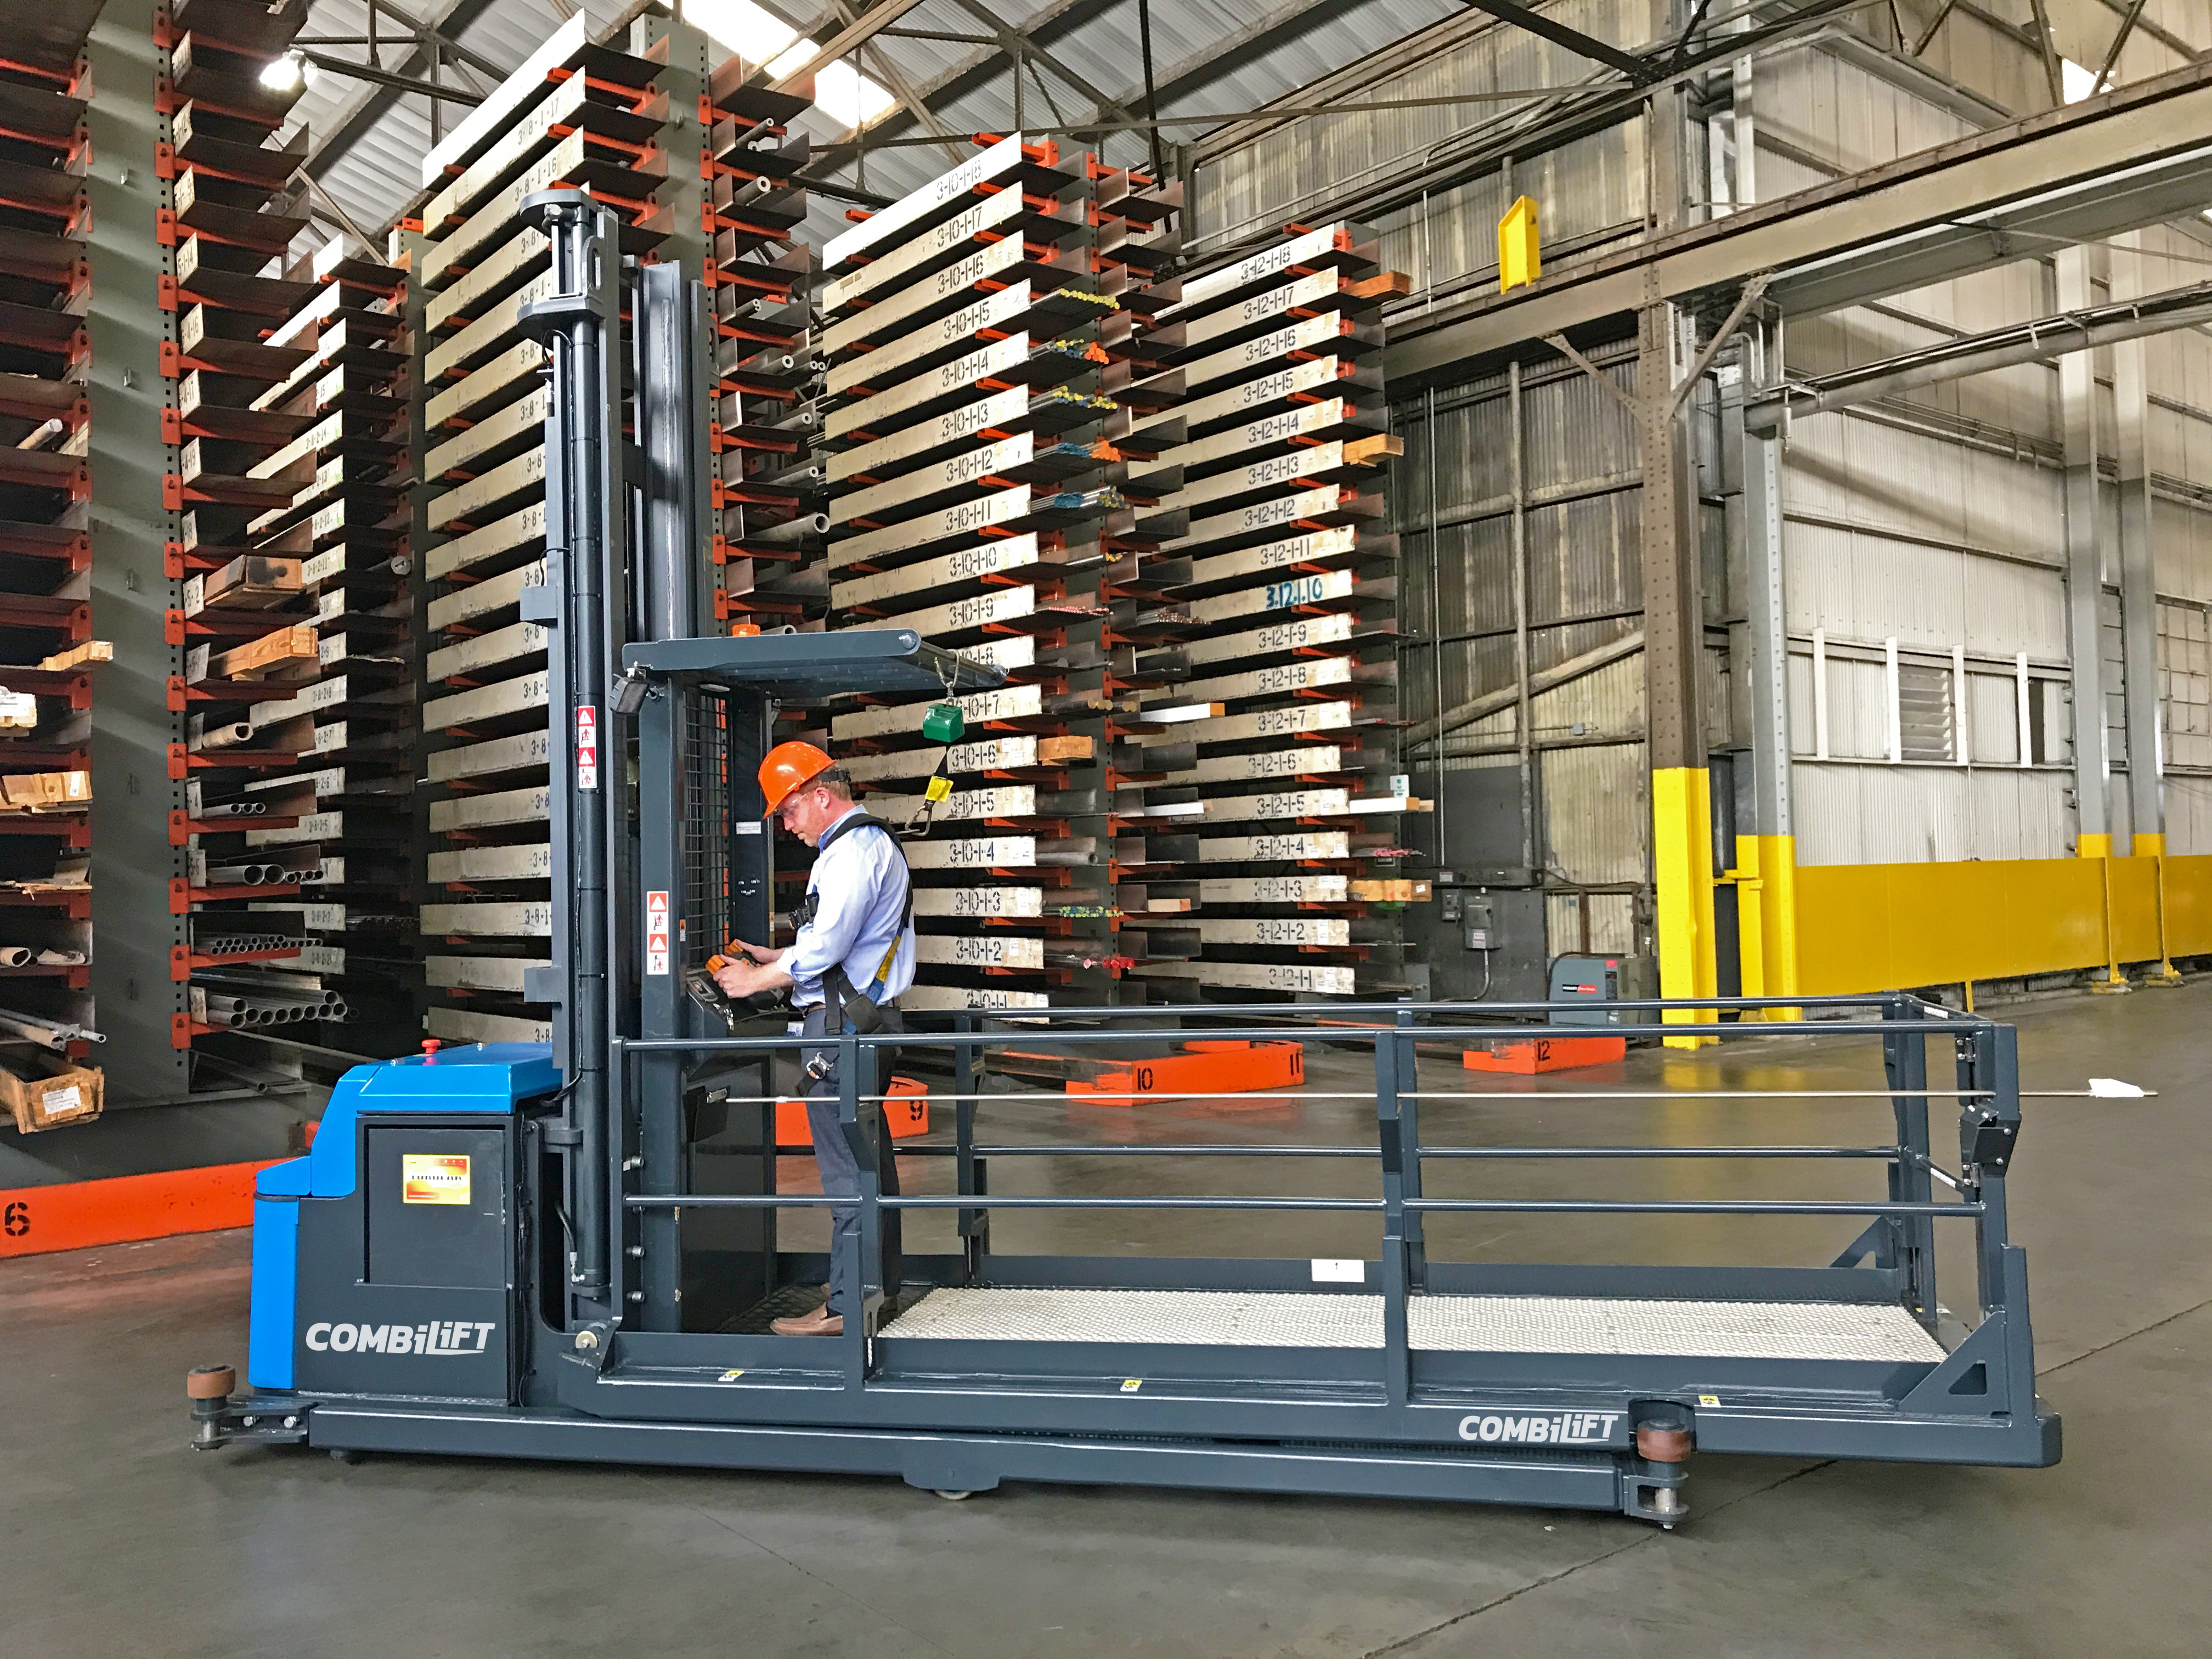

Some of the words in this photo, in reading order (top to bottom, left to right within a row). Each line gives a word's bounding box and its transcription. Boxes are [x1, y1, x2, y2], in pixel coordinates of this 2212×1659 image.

[518, 97, 560, 145] 3-8-1-17
[515, 162, 556, 202] 3-8-1-16
[936, 159, 981, 201] 3-10-1-18
[937, 205, 983, 248] 3-10-1-17
[938, 253, 984, 294] 3-10-1-16
[1242, 246, 1291, 280] 3-12-1-18
[1244, 286, 1295, 320] 3-12-1-17
[944, 301, 990, 339] 3-10-1-15
[1245, 329, 1296, 361] 3-12-1-16
[942, 351, 989, 387] 3-10-1-14
[1244, 371, 1294, 403] 3-12-1-15
[942, 403, 988, 437] 3-10-1-13
[1248, 414, 1299, 444] 3-12-1-14
[946, 449, 993, 482] 3-10-1-12
[1248, 456, 1299, 486] 3-12-1-13
[946, 500, 990, 531] 3-10-1-11
[1245, 499, 1295, 527] 3-12-1-12
[950, 546, 997, 577] 3-10-1-10
[1260, 538, 1310, 566] 3-12-1-11
[950, 597, 994, 627] 3-10-1-9
[1259, 624, 1307, 649] 3-12-1-9
[1259, 667, 1306, 690] 3-12-1-8
[1258, 709, 1306, 732] 3-12-1-7
[951, 744, 996, 768] 3-10-1-6
[1248, 753, 1296, 776] 3-12-1-6
[950, 792, 995, 816] 3-10-1-5
[1257, 794, 1305, 816] 3-12-1-5
[950, 842, 994, 864] 3-10-1-4
[1256, 837, 1304, 858] 3-12-1-4
[955, 891, 1001, 912] 3-10-1-3
[1254, 880, 1302, 899] 3-12-1-3
[1256, 922, 1305, 940] 3-12-1-2
[956, 939, 1002, 961] 3-10-1-2
[1290, 1053, 1300, 1076] 11
[1536, 1041, 1551, 1062] 12
[1137, 1067, 1153, 1091] 10
[910, 1099, 923, 1121] 9
[4, 1201, 30, 1236] 6
